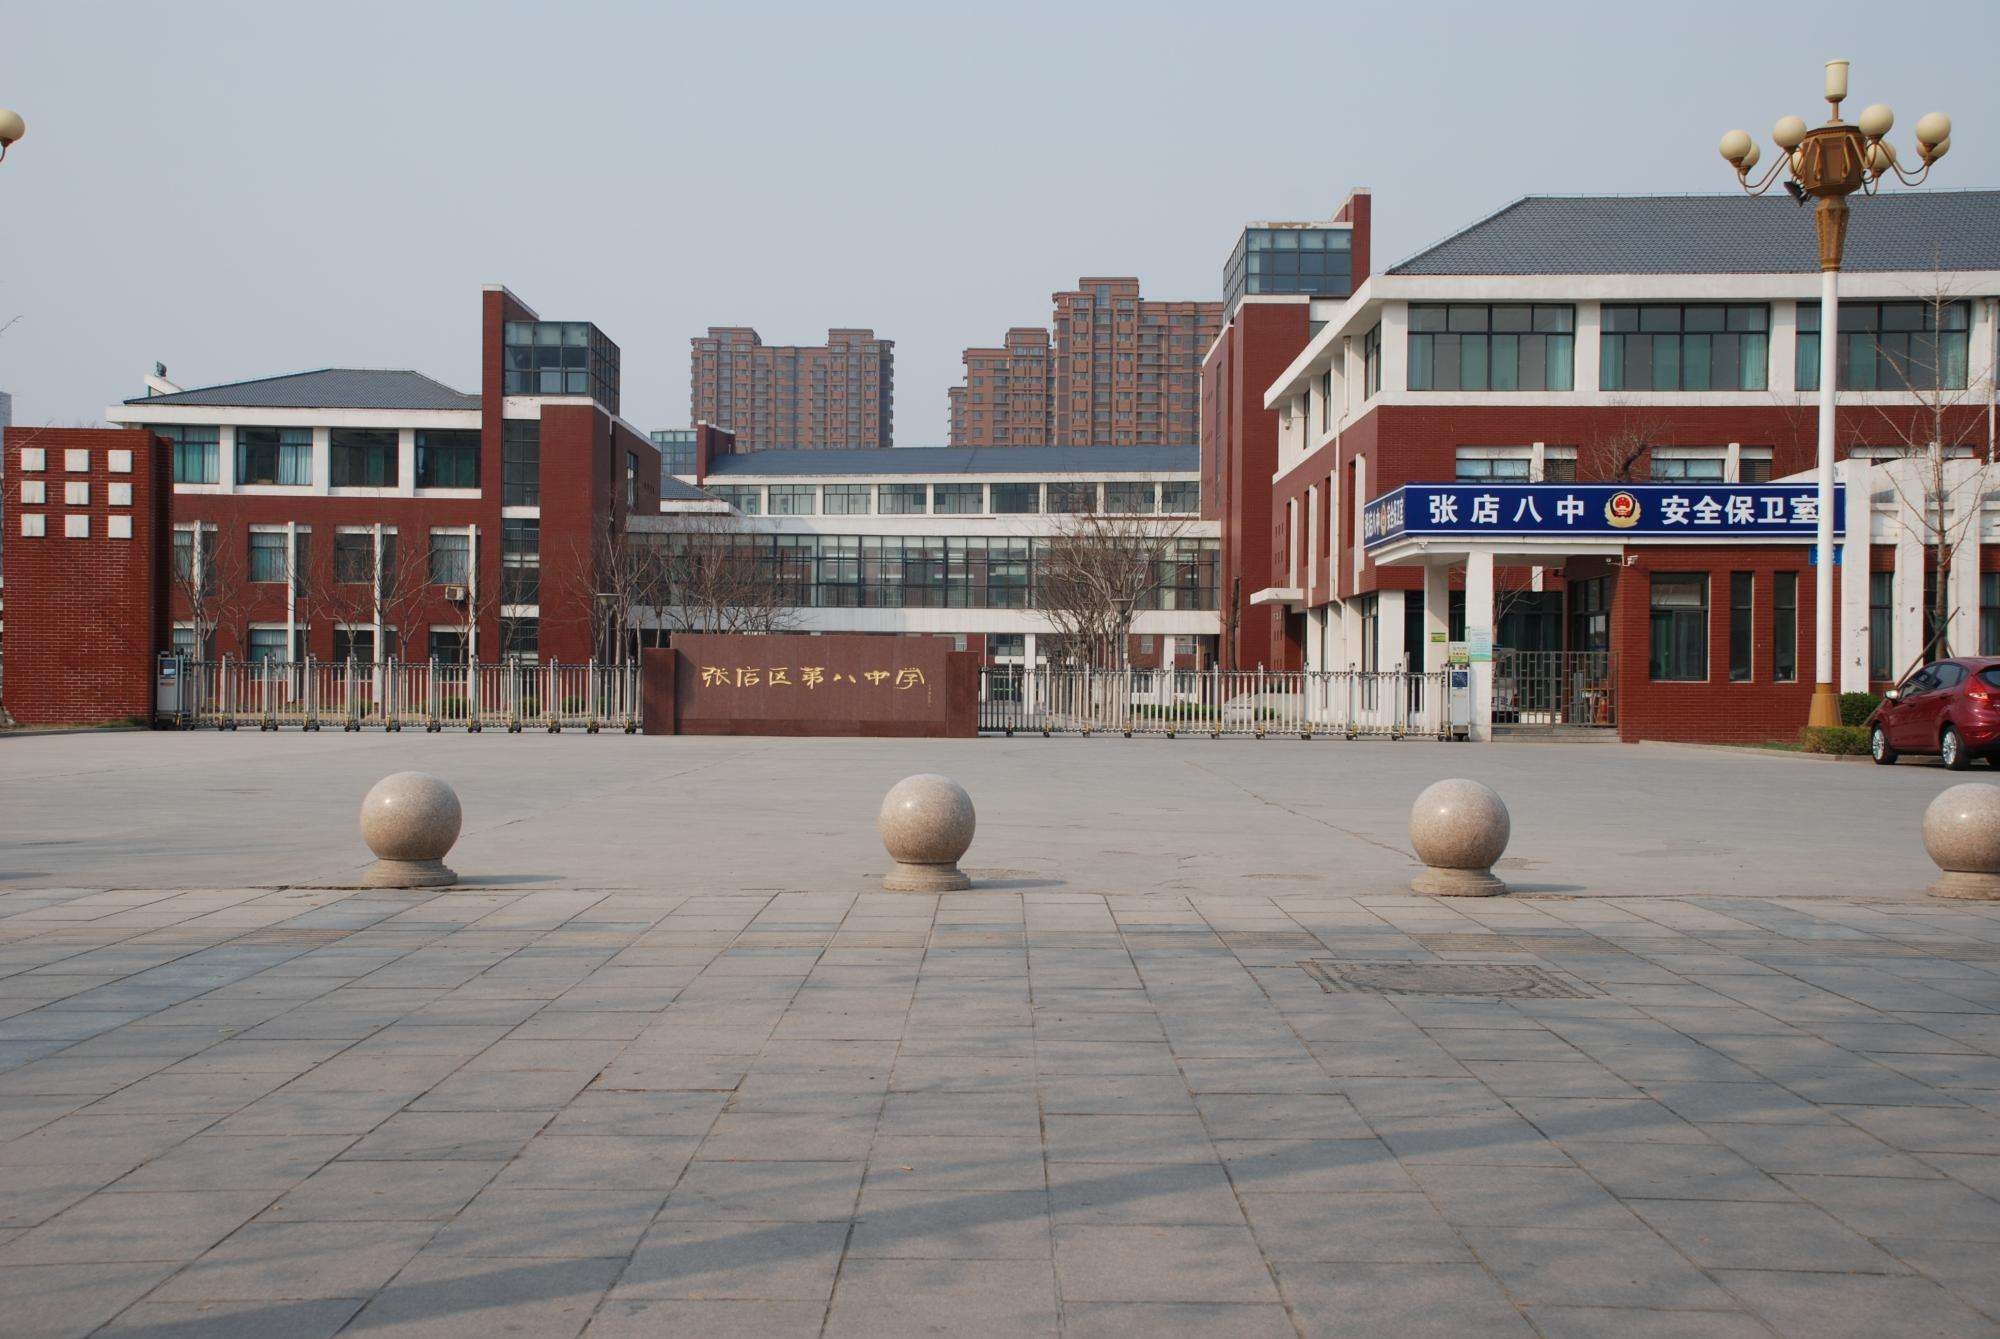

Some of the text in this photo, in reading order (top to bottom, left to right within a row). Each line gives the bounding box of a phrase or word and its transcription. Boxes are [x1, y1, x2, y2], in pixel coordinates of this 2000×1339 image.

[1429, 494, 1820, 525] 张店八中 安全保卫室
[701, 666, 925, 690] 张店区第八中学
